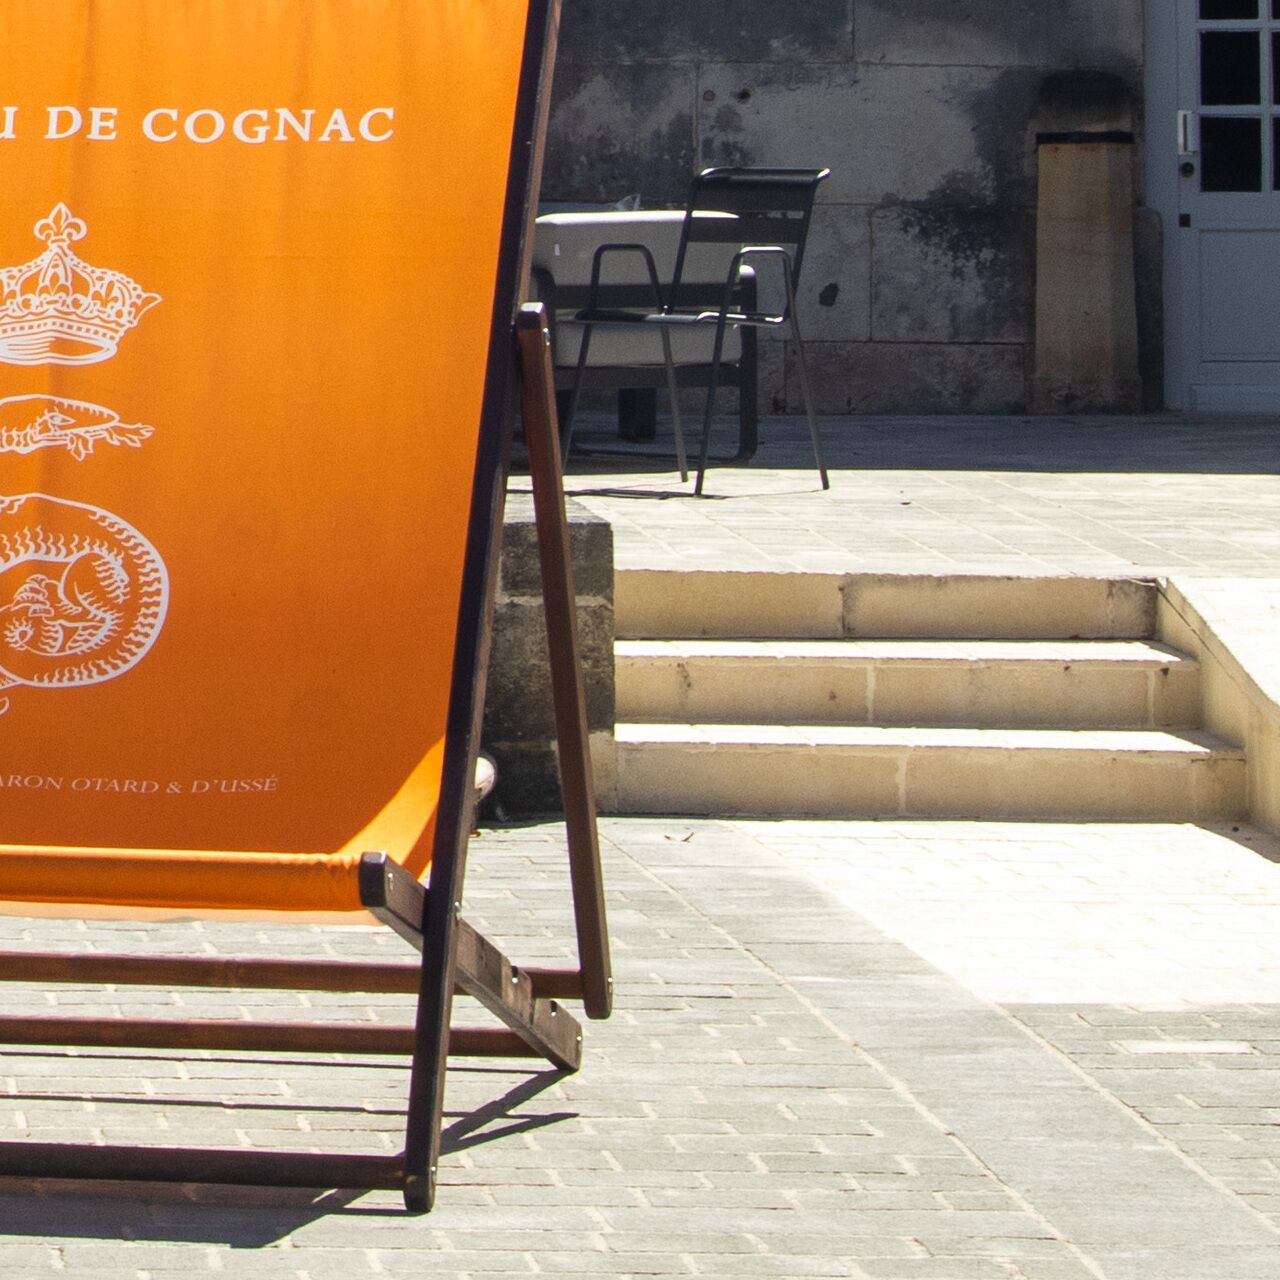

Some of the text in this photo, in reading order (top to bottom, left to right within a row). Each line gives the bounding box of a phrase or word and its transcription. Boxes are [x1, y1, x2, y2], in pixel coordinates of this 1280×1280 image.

[44, 106, 119, 141] DE
[142, 107, 395, 144] COGNAC
[71, 778, 160, 794] OTARD
[166, 781, 183, 794] &
